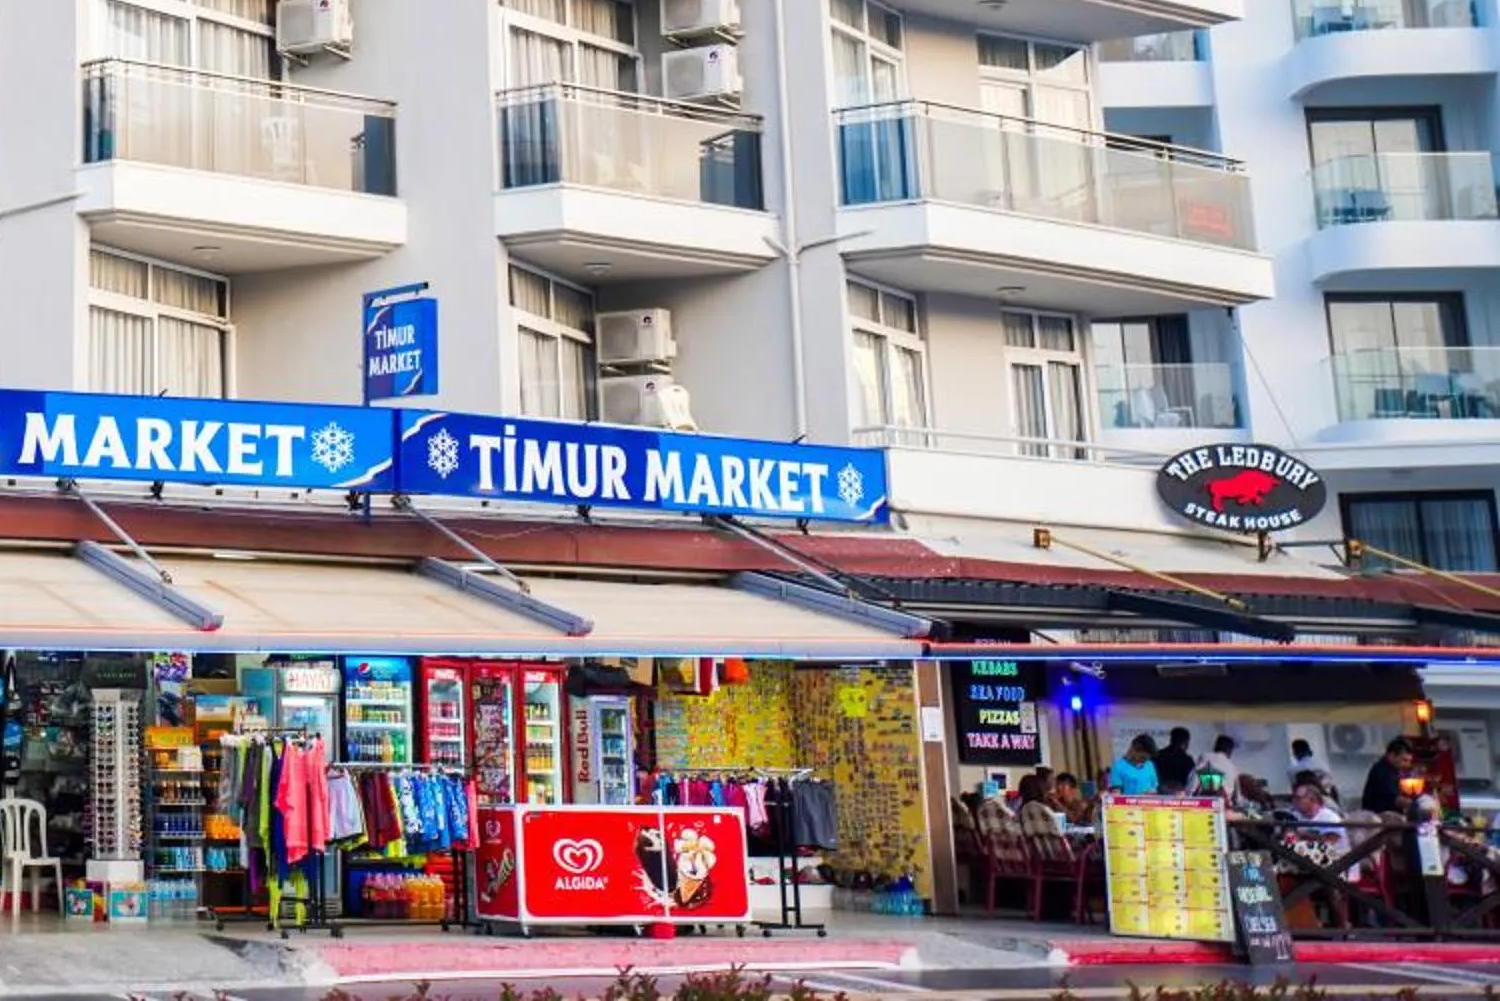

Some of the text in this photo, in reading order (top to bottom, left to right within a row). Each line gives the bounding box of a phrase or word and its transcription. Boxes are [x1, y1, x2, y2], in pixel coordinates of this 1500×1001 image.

[374, 324, 415, 350] TİMUR
[368, 349, 422, 378] MARKET
[17, 411, 306, 478] MARKET
[469, 424, 830, 514] TİMUR MARKET
[1165, 446, 1320, 491] THE LEDBURY
[1184, 502, 1303, 530] STEAK HOUSE
[979, 708, 1021, 726] PIZZAS
[554, 876, 606, 891] ALGIDA
